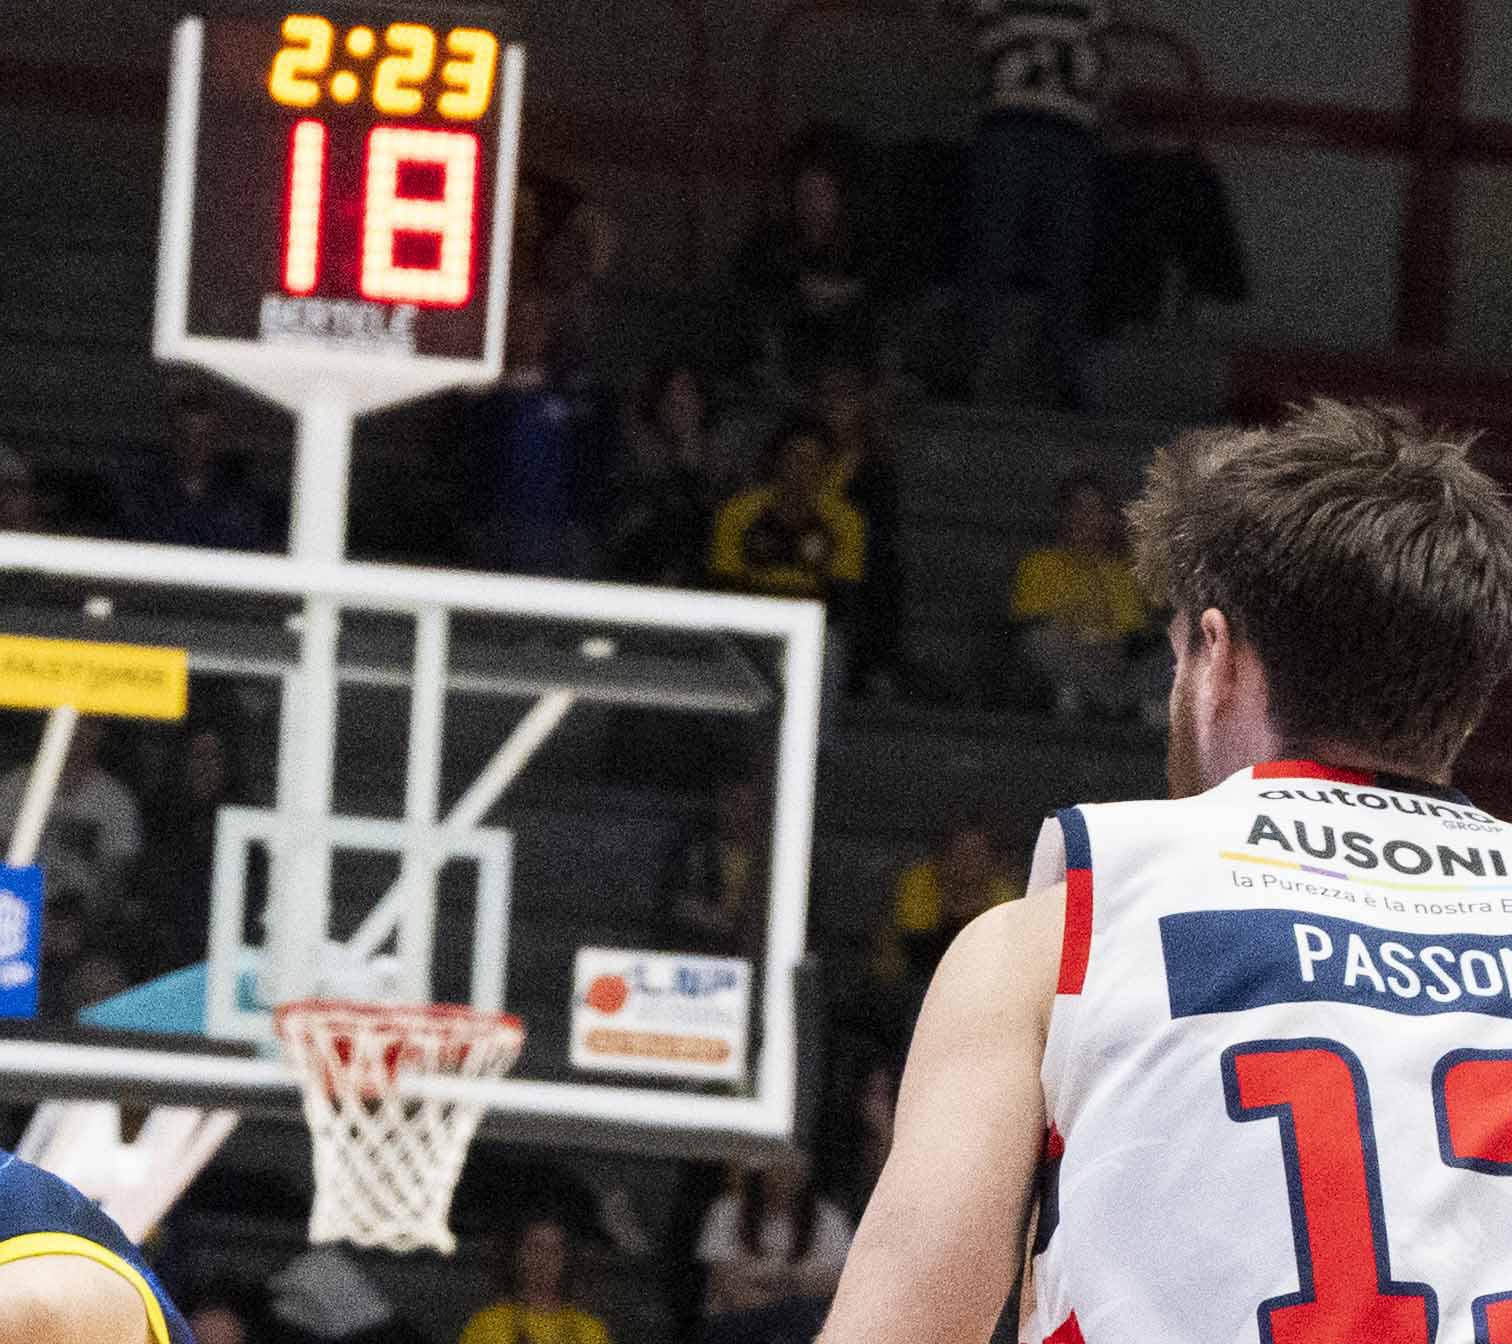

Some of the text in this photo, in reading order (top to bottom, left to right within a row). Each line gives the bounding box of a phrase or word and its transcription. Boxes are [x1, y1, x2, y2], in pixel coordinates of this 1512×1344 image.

[270, 14, 497, 120] 2:23
[282, 118, 479, 309] 18
[1232, 870, 1254, 889] la
[1263, 873, 1356, 903] Purezza
[1384, 896, 1406, 914] la
[1414, 899, 1493, 917] nostra
